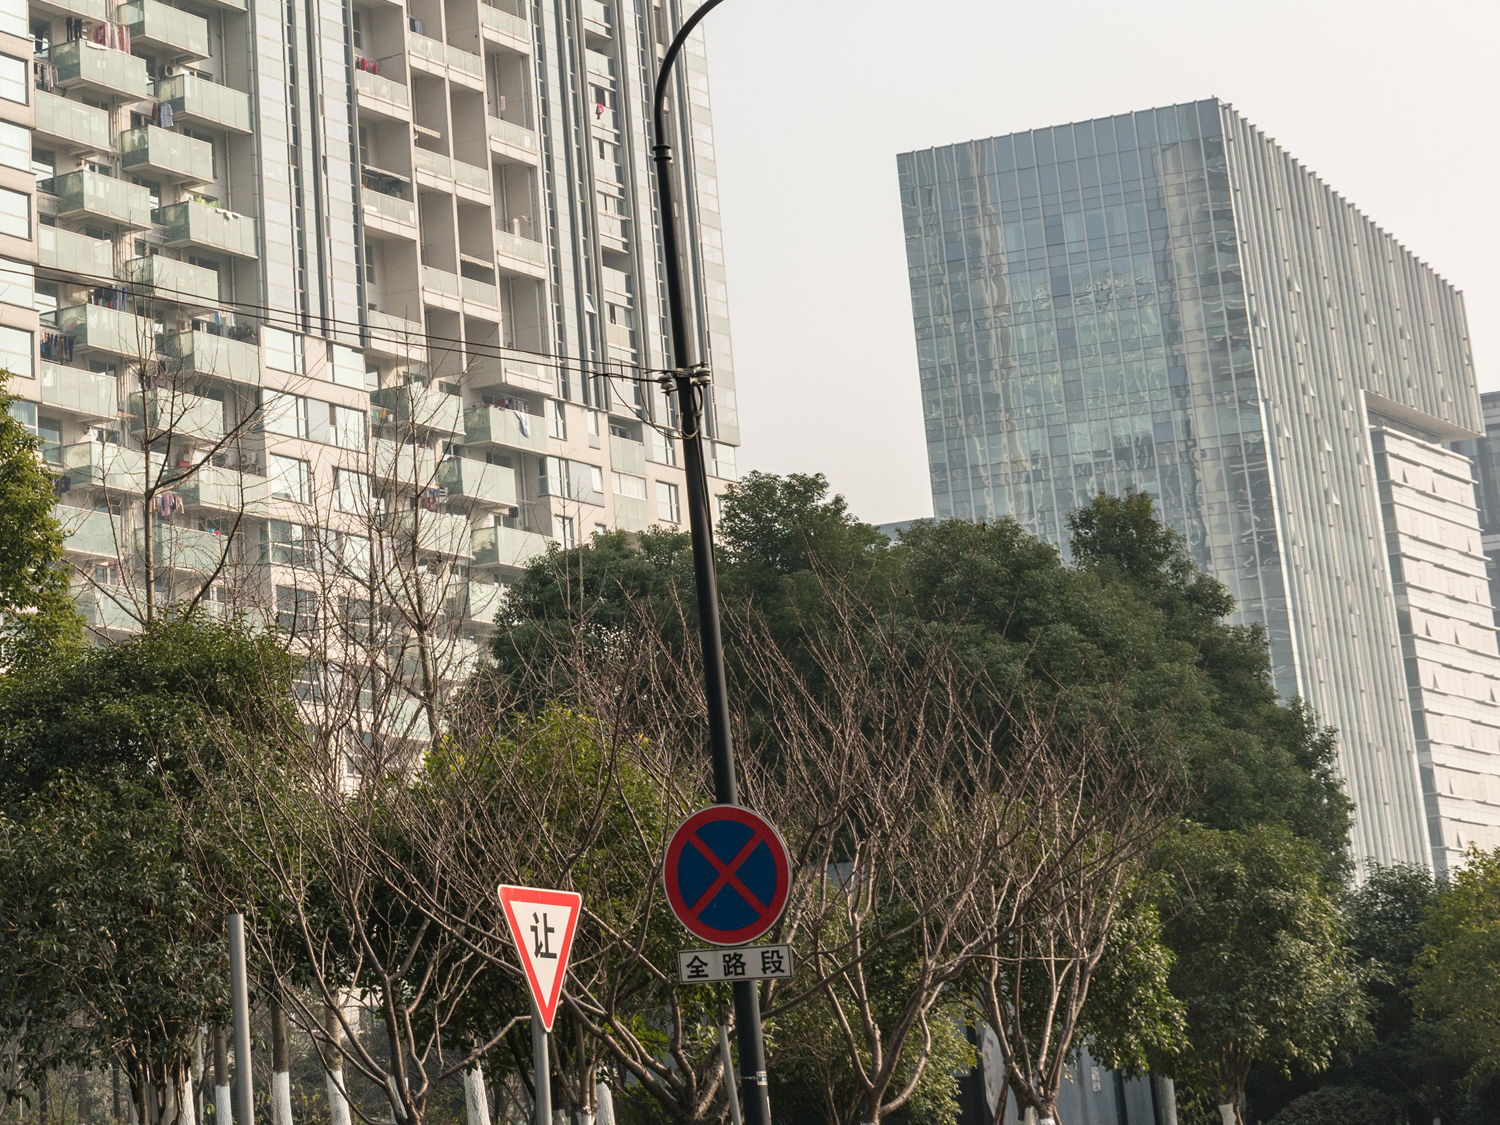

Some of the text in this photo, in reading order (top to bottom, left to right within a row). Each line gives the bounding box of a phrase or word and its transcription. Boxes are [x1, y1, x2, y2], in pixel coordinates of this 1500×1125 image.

[530, 911, 557, 959] 让
[686, 950, 785, 979] 全路段
